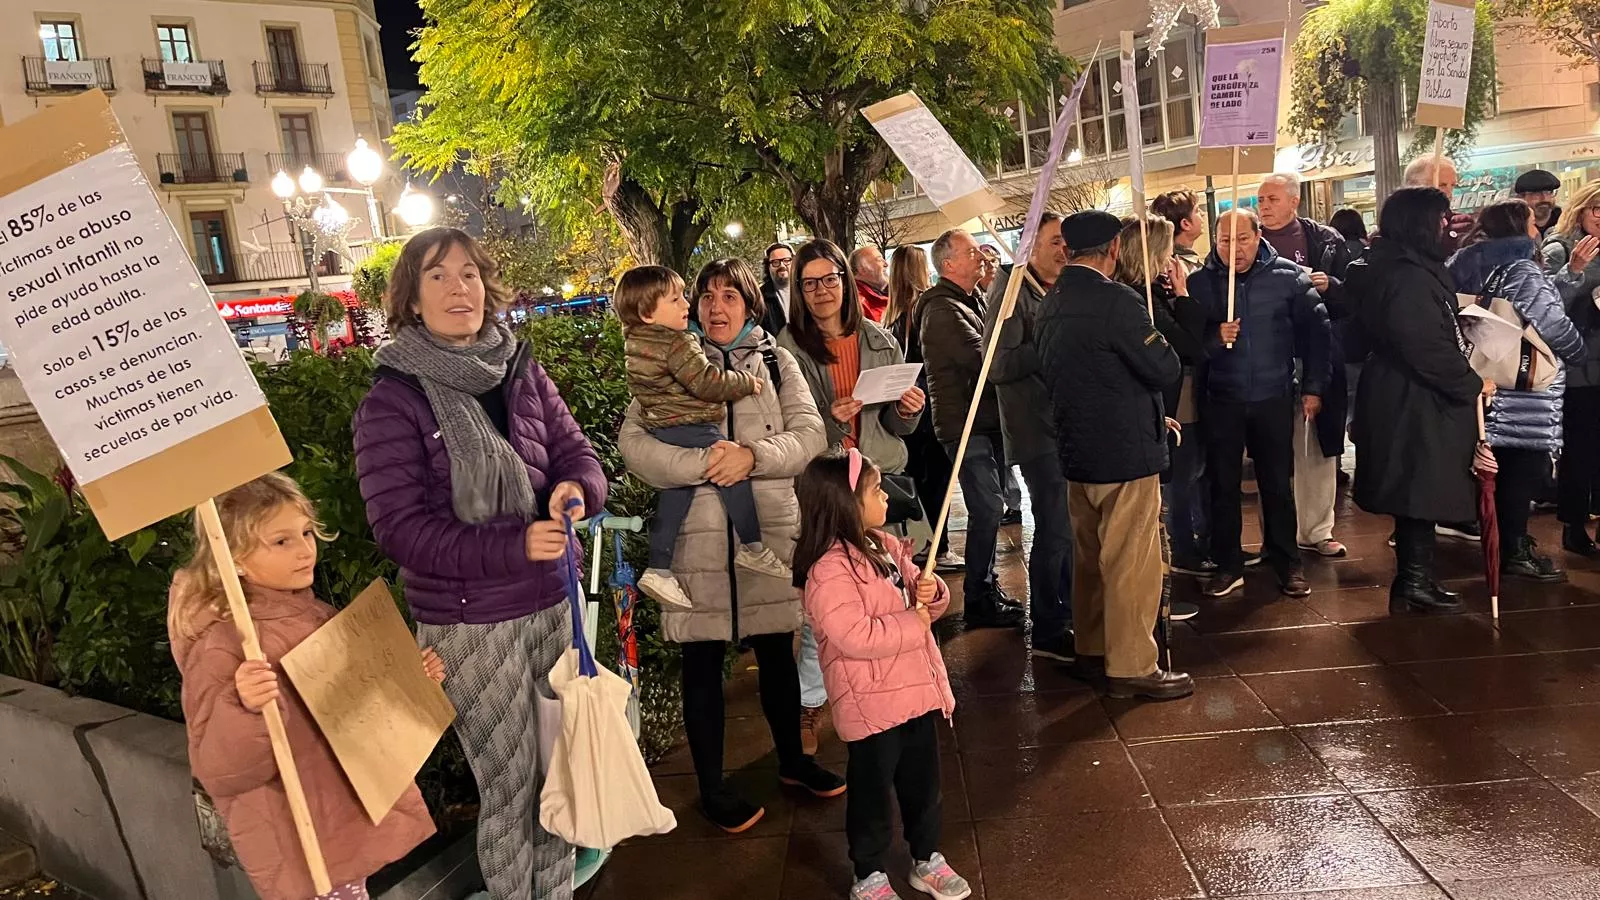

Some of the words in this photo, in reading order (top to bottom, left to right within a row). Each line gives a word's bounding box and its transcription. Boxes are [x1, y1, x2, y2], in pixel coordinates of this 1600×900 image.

[1433, 11, 1457, 31] Aborto
[1210, 91, 1242, 100] CAMBIE
[1212, 74, 1227, 83] QUE
[1229, 73, 1239, 81] LA
[1426, 67, 1434, 76] en
[1221, 100, 1242, 108] LADO
[7, 204, 54, 238] 85%
[57, 202, 77, 216] de
[78, 191, 102, 207] las
[0, 245, 53, 276] íctimas
[56, 235, 75, 250] de
[79, 210, 131, 239] abuso
[8, 266, 62, 302] sexual
[62, 240, 121, 276] infantil
[124, 236, 144, 250] no
[14, 303, 48, 328] pide
[51, 281, 99, 309] ayuda
[99, 262, 143, 287] hasta
[143, 253, 161, 269] la
[51, 308, 91, 334] edad
[94, 287, 147, 316] adulta.
[43, 356, 75, 376] Solo
[78, 345, 92, 360] el
[92, 320, 140, 352] 15%
[143, 316, 163, 332] de
[164, 306, 188, 323] los
[55, 375, 97, 399] casos
[99, 367, 116, 380] se
[119, 330, 203, 372] denuncian.
[85, 378, 145, 411] Muchas
[147, 369, 167, 384] de
[168, 358, 192, 375] las
[94, 399, 156, 431] víctimas
[156, 378, 204, 405] tienen
[84, 427, 148, 462] secuelas
[150, 417, 170, 432] de
[173, 404, 198, 425] por
[200, 388, 238, 410] vida.
